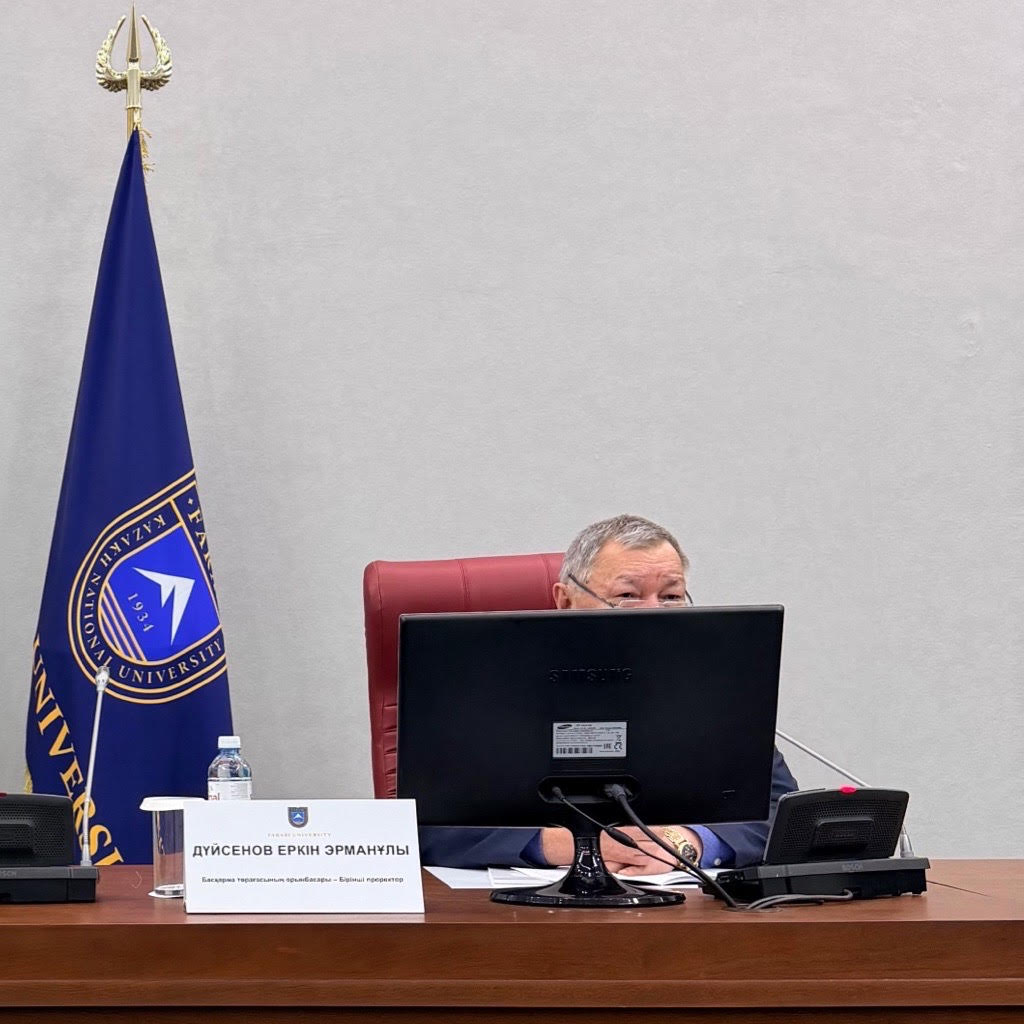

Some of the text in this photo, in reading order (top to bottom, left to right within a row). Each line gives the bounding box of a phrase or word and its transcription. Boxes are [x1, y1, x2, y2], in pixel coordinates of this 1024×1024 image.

[100, 513, 167, 568] KAZAKH
[127, 592, 155, 633] 1934
[118, 638, 223, 685] UNIVERSITY
[192, 843, 273, 858] ДҮЙСЕНОВ
[277, 845, 321, 857] ЕРКІН
